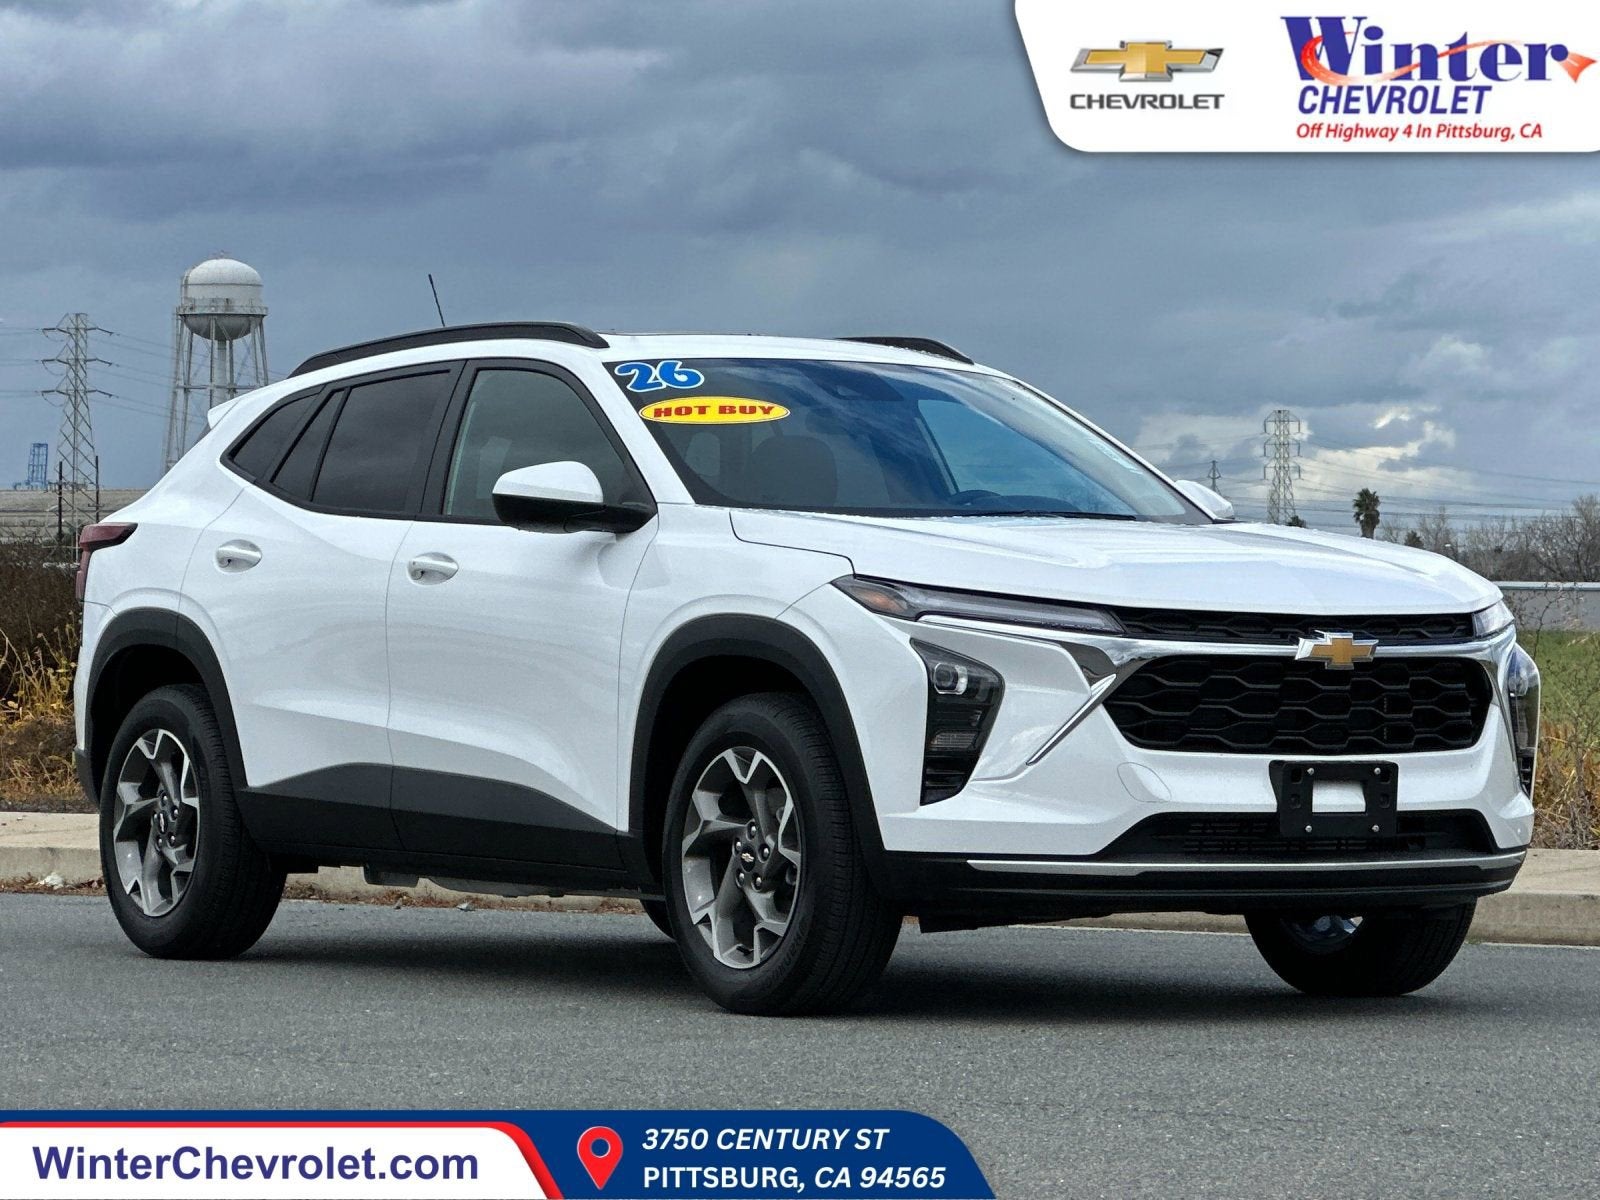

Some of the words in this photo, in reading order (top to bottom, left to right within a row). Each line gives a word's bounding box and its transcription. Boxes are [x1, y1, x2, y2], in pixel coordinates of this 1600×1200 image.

[614, 360, 705, 393] 26
[653, 405, 711, 418] HOT
[718, 404, 776, 415] BUY
